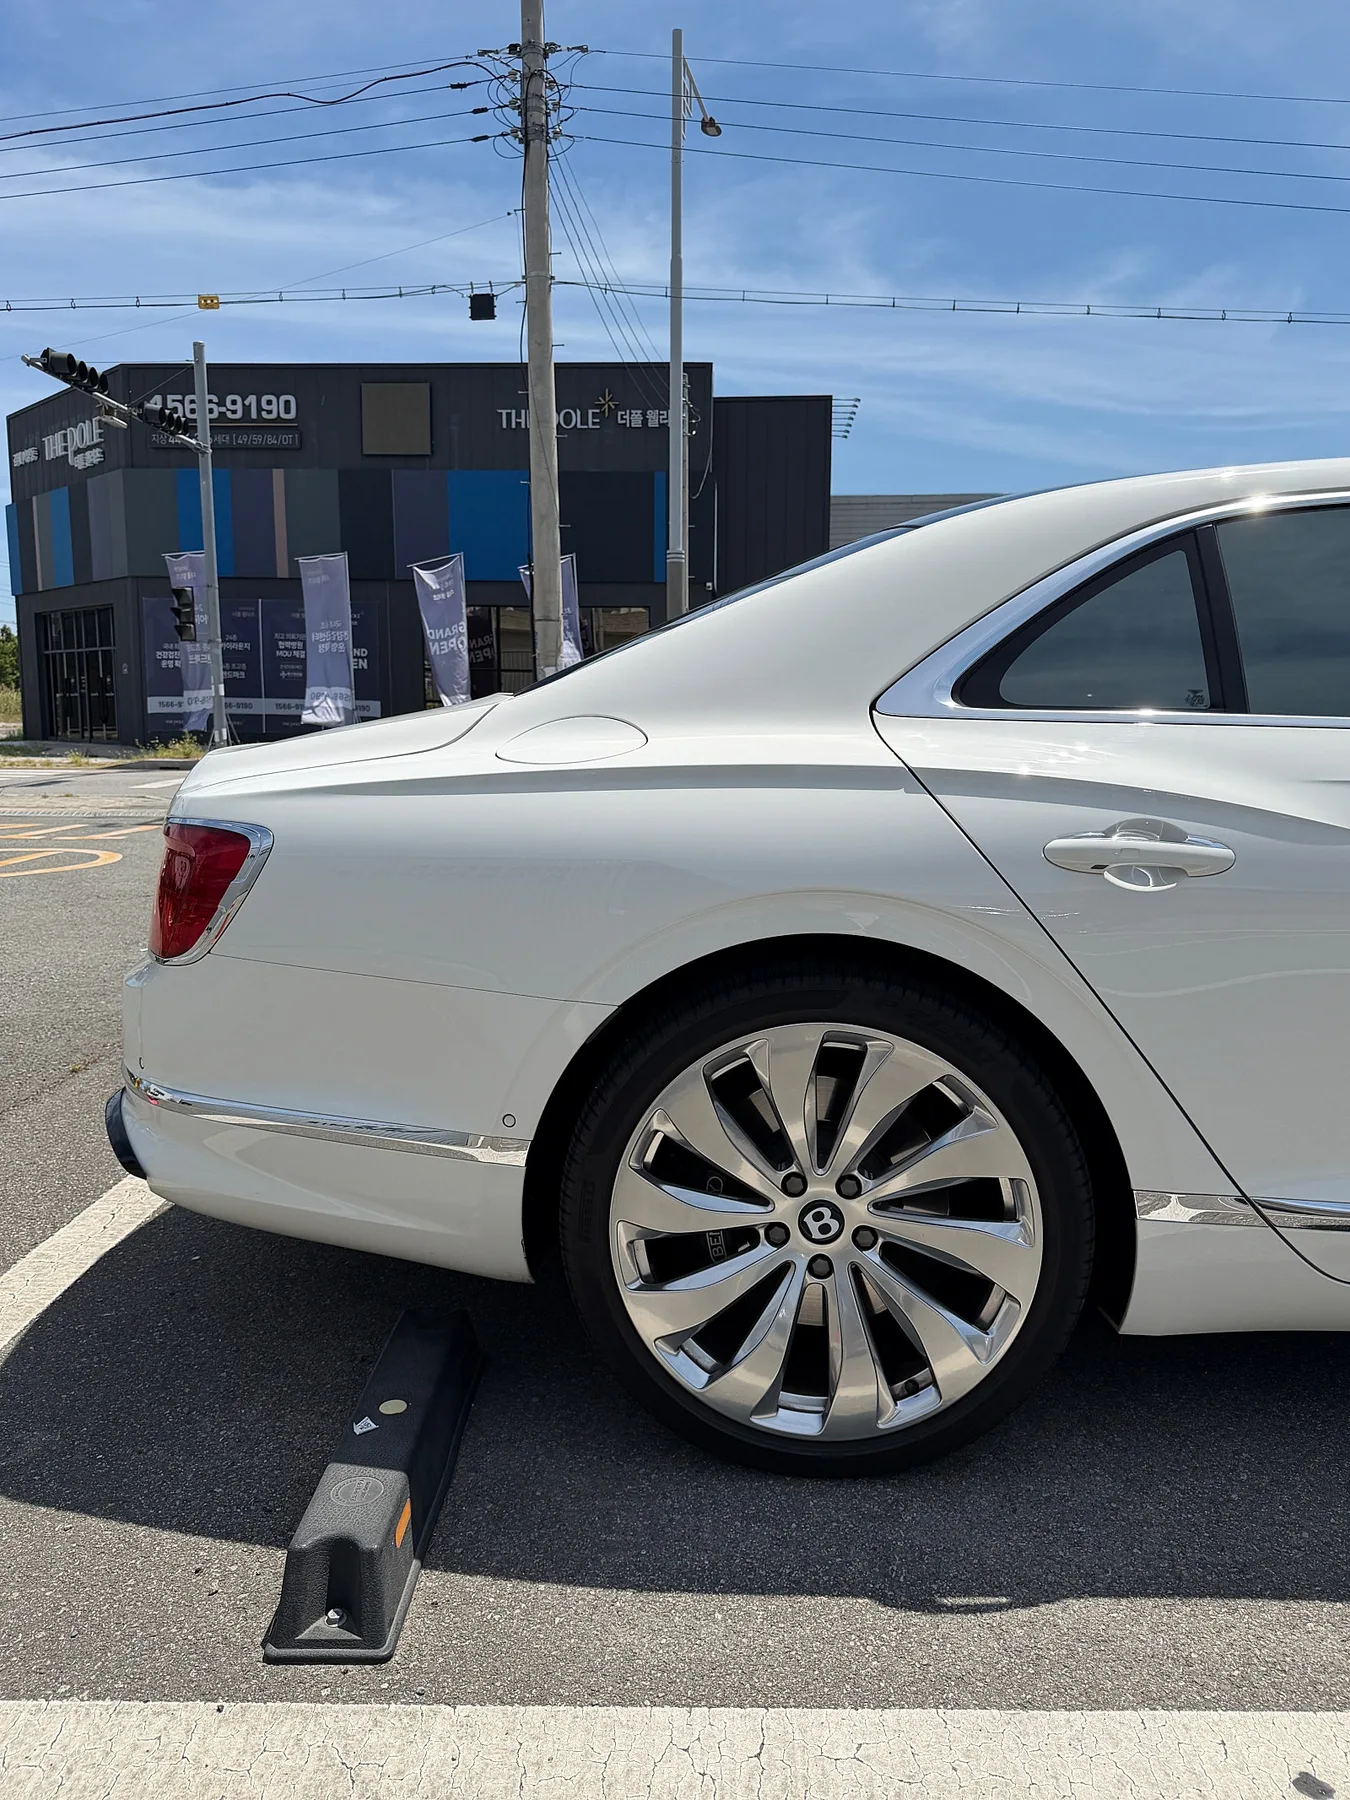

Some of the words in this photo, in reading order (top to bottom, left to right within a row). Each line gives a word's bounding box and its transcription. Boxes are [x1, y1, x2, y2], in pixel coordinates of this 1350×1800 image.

[496, 409, 531, 429] TH
[555, 408, 601, 429] OLE
[617, 410, 643, 428] 더폴
[42, 430, 68, 461] THE
[276, 650, 292, 658] MOU
[352, 658, 369, 670] EN
[802, 1206, 841, 1240] B
